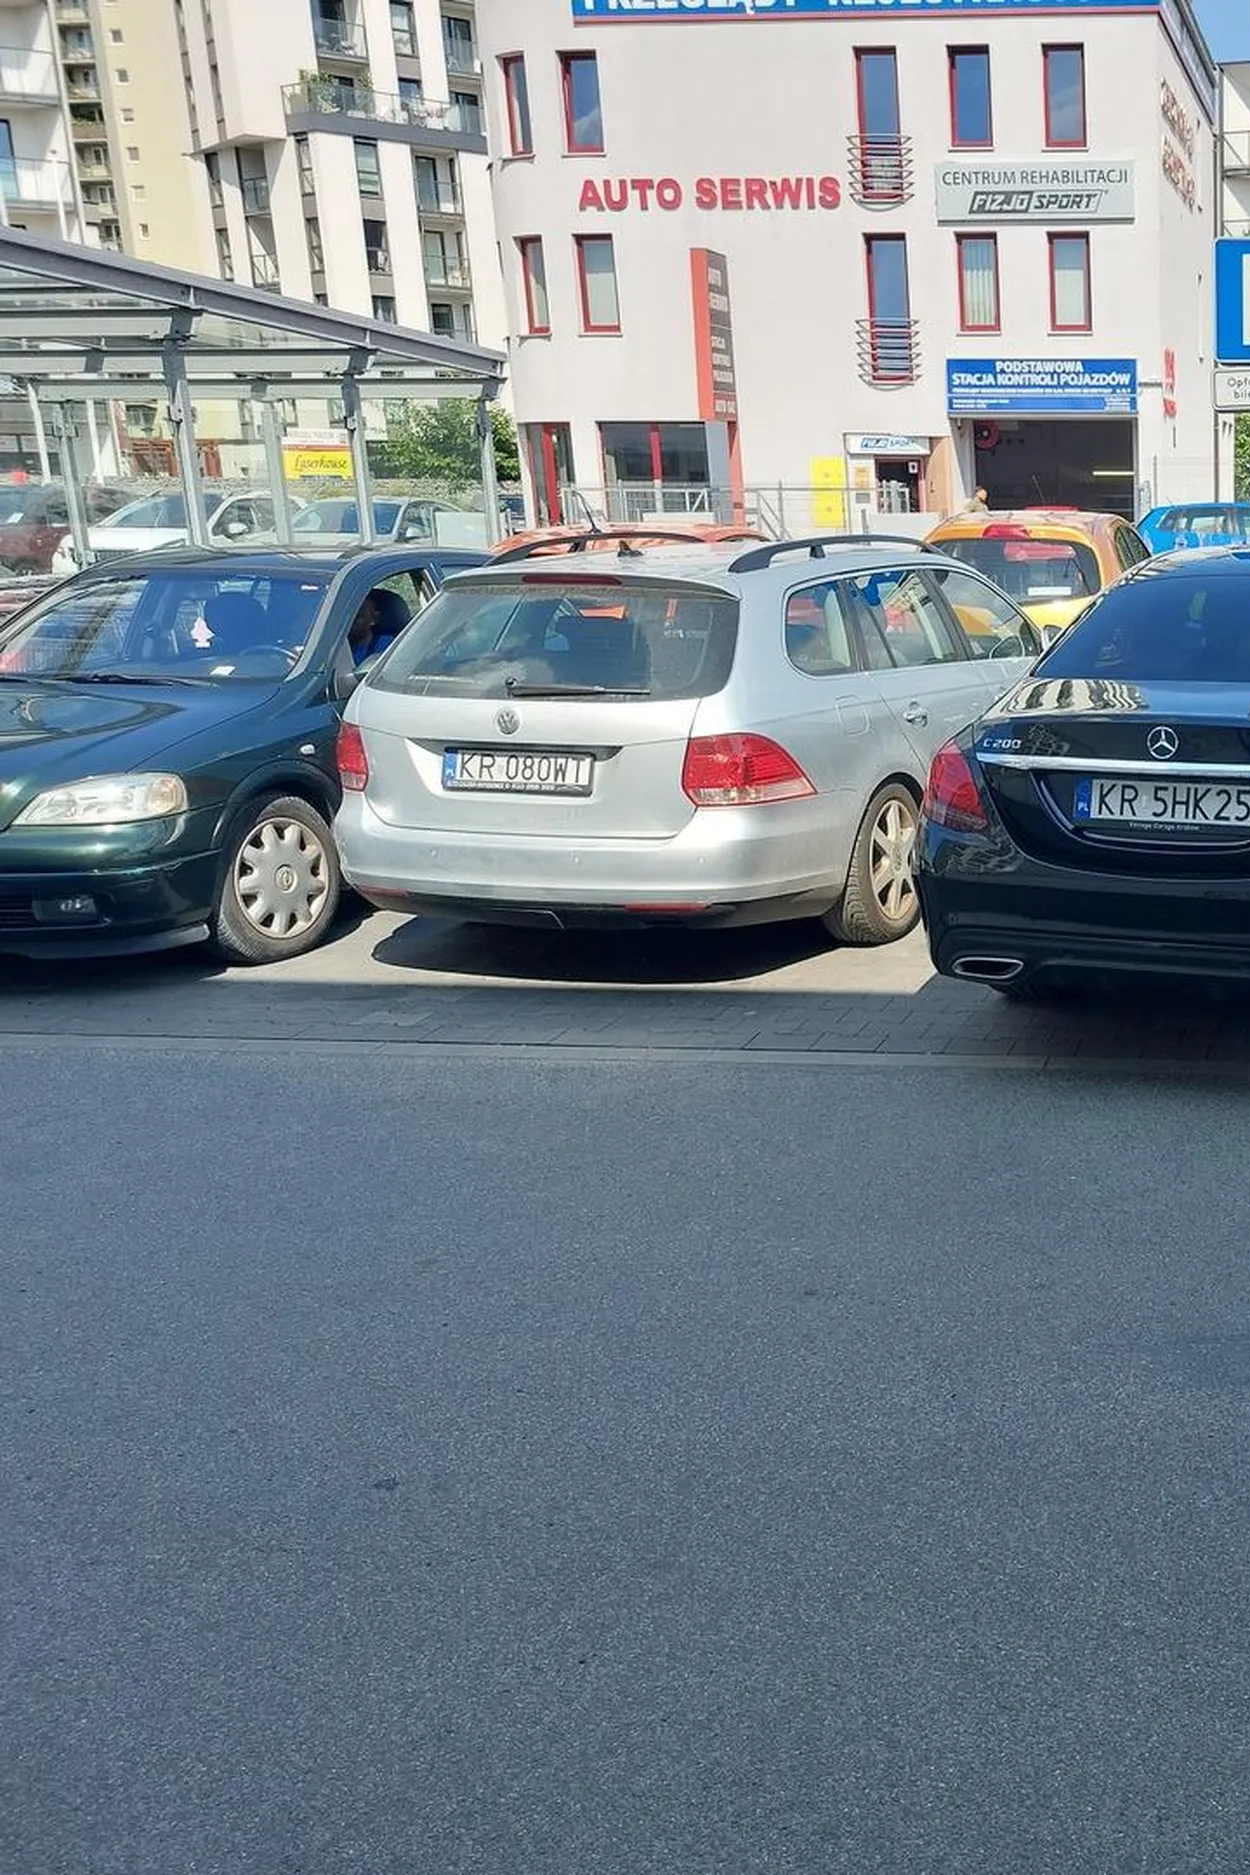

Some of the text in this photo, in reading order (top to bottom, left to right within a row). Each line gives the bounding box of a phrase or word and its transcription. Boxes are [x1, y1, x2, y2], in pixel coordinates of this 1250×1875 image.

[942, 168, 1129, 185] CENTRUM REHABILITACJI
[579, 176, 841, 212] AUTO SERWIS
[1033, 193, 1098, 210] SPORT
[995, 360, 1084, 373] PODSTAWOWA
[952, 371, 1131, 386] STACJA KONTROLI POJAZDÓW
[459, 752, 586, 783] KR 080WT
[1098, 783, 1139, 817] KR
